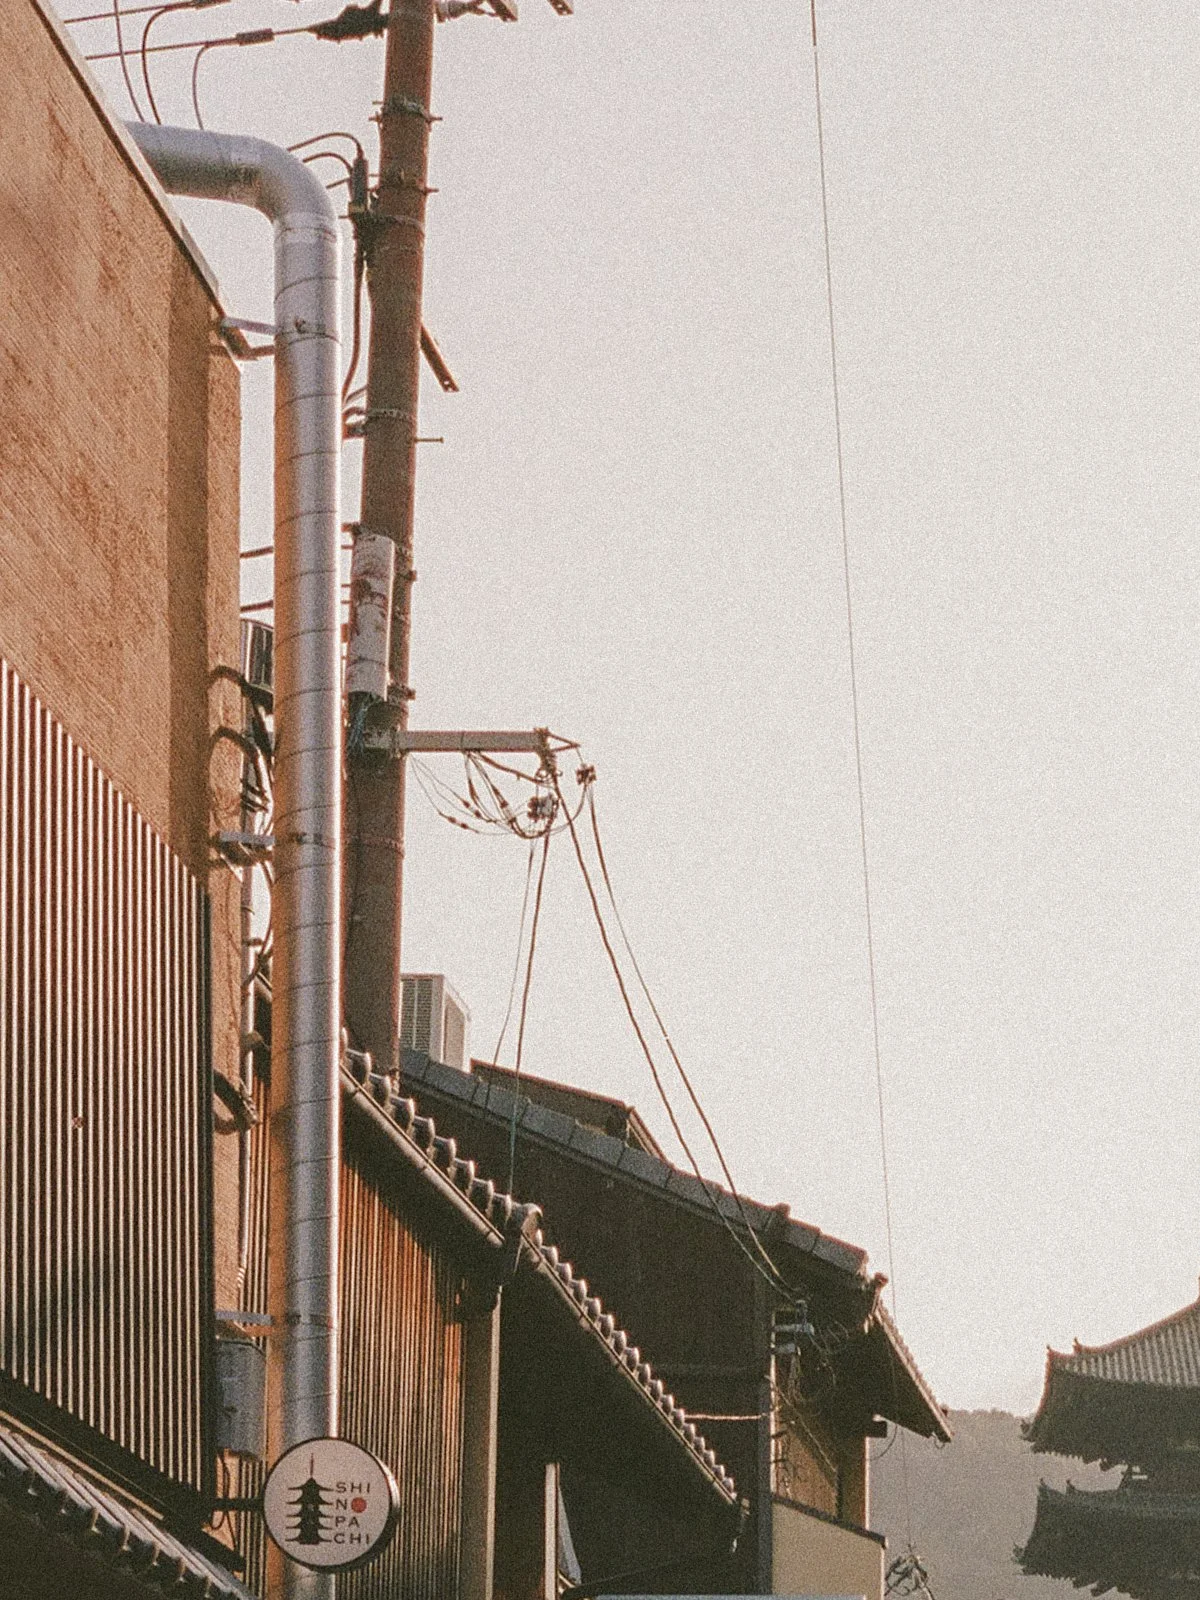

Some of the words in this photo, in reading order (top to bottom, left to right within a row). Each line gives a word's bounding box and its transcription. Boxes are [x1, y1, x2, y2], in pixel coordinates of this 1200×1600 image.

[336, 1481, 371, 1494] SHI
[335, 1499, 348, 1511] N
[335, 1516, 360, 1528] PA
[333, 1533, 370, 1545] CHI
